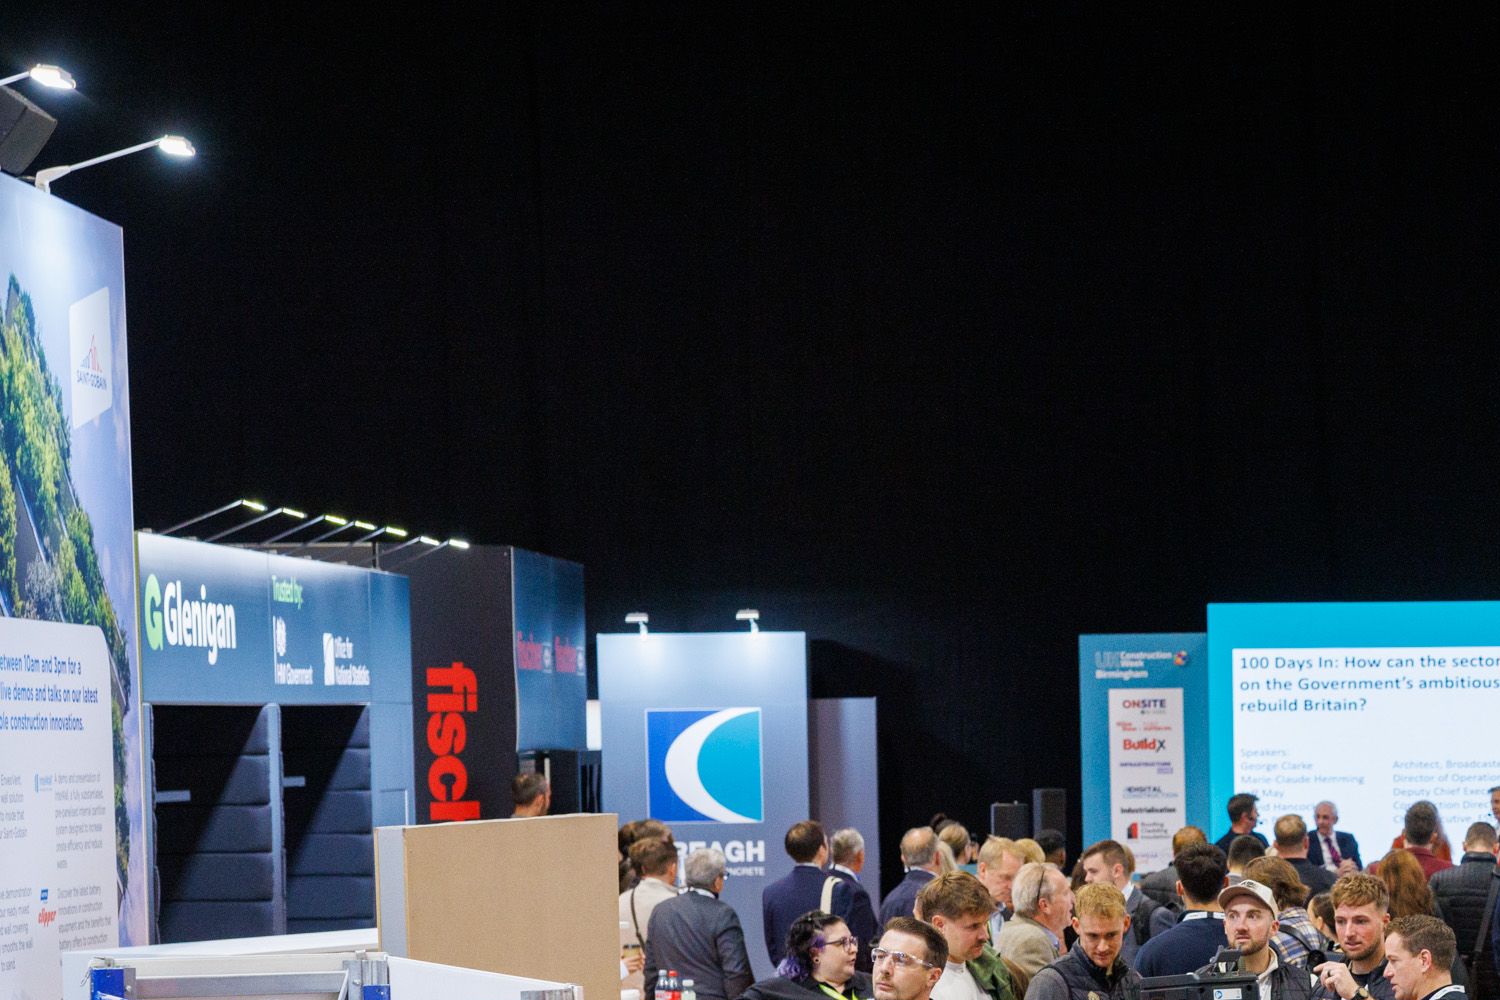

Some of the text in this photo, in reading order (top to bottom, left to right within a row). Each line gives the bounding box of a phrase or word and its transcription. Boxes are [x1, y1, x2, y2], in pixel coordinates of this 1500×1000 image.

[164, 580, 236, 665] Glenigan
[1120, 651, 1172, 661] Construction
[24, 655, 40, 672] 10am
[41, 656, 52, 674] and
[54, 656, 67, 677] 3pm
[68, 657, 77, 675] for
[1120, 660, 1144, 668] Week
[1240, 657, 1269, 670] 100
[1275, 656, 1313, 673] Days
[1318, 656, 1339, 669] In:
[1345, 656, 1381, 669] How
[1386, 658, 1414, 669] can
[1420, 656, 1447, 669] the
[1452, 656, 1500, 669] sector
[1095, 669, 1149, 681] Birmingham
[1240, 680, 1260, 691] on
[1266, 677, 1293, 691] the
[1298, 676, 1414, 691] Government’s
[1418, 675, 1500, 690] ambitious
[14, 685, 34, 701] demos
[35, 687, 47, 702] and
[48, 687, 61, 702] talks
[63, 691, 71, 702] on
[72, 692, 81, 703] our
[83, 688, 98, 704] latest
[1122, 699, 1167, 709] ONSITE
[1240, 698, 1367, 713] rebuild Britain?
[10, 713, 84, 731] construction innovations.
[1123, 738, 1166, 753] BuildX
[1241, 762, 1313, 771] George Clarke
[1393, 760, 1443, 770] Architect,
[1393, 774, 1435, 783] Director
[1437, 773, 1449, 782] of
[1393, 787, 1431, 798] Deputy
[1434, 786, 1460, 795] Chief
